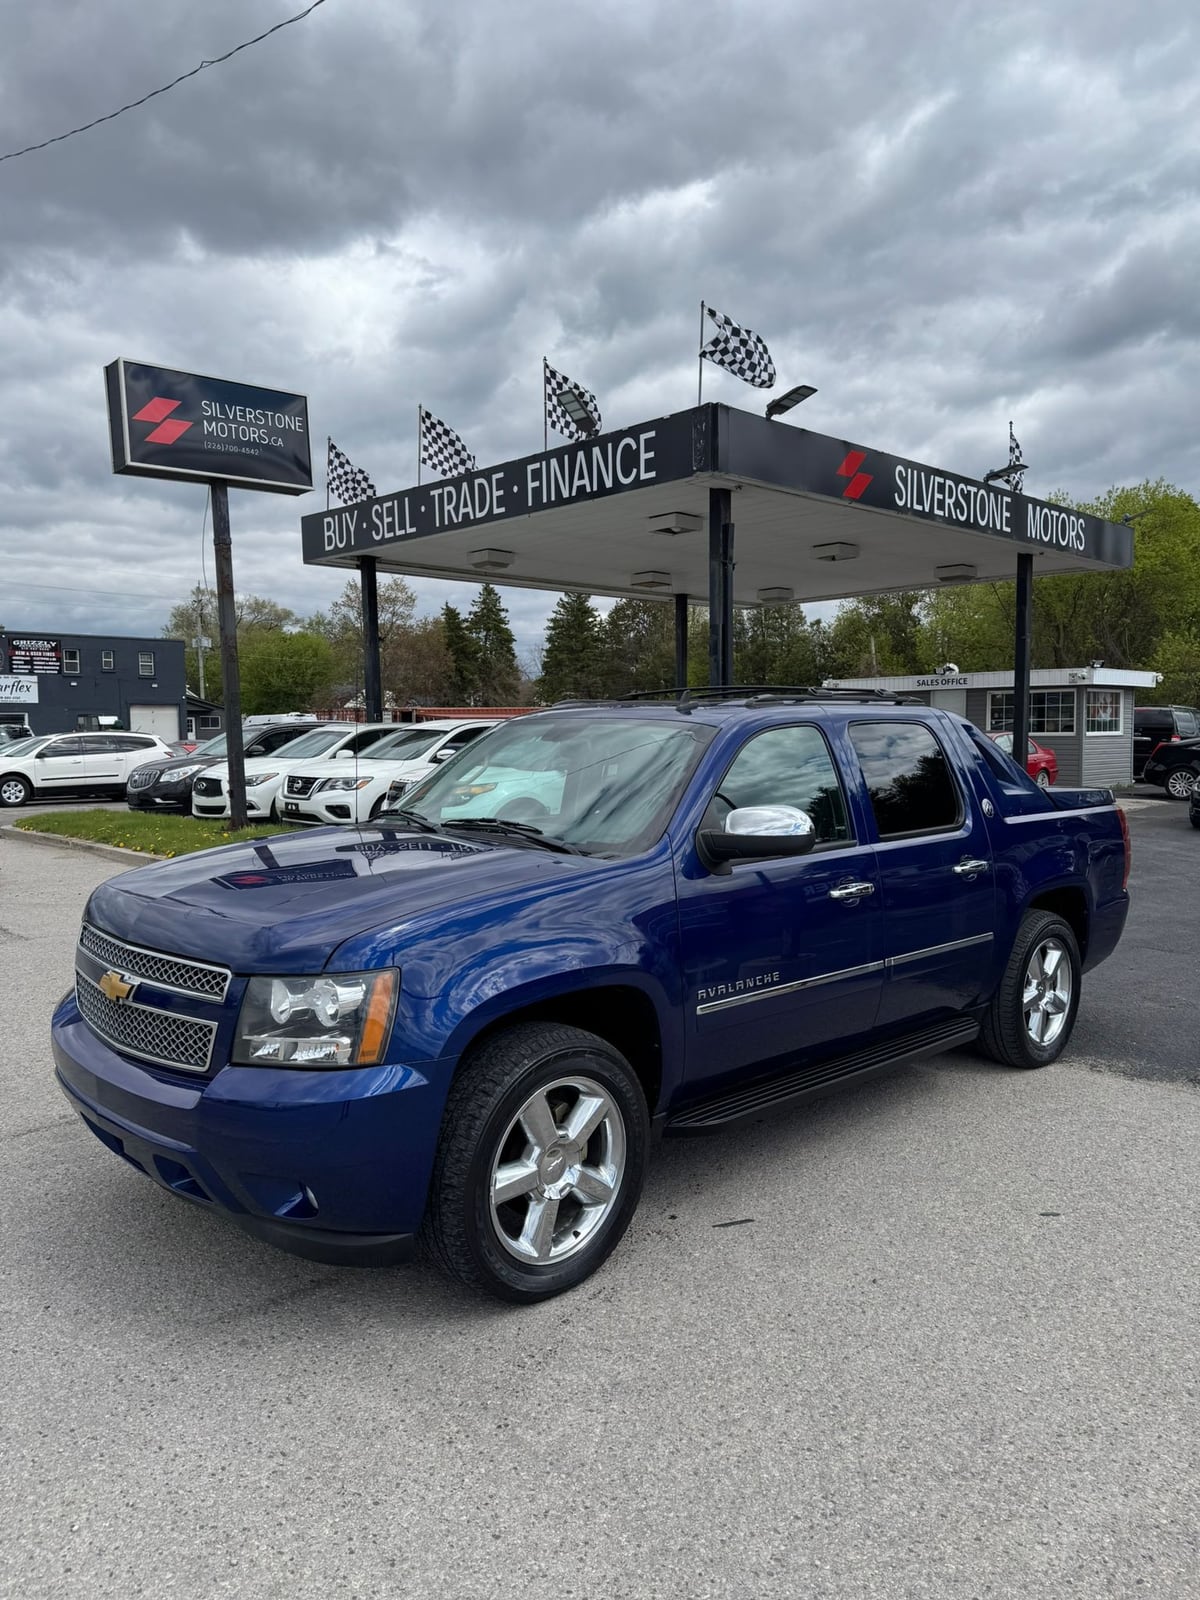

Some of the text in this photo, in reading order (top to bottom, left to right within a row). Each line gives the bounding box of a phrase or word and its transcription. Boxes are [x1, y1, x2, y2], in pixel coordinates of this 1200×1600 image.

[201, 400, 304, 433] SILVERSTONE
[203, 419, 284, 447] MOTORS.CA
[204, 441, 260, 456] (226)700-4542
[323, 430, 657, 552] BUY SELL TRADE FINANCE
[894, 464, 1086, 551] SILVERSTONE MOTORS
[12, 639, 57, 647] GRIZZLY
[916, 677, 969, 687] SALES OFFICE
[697, 971, 780, 1000] AVALANCHE
